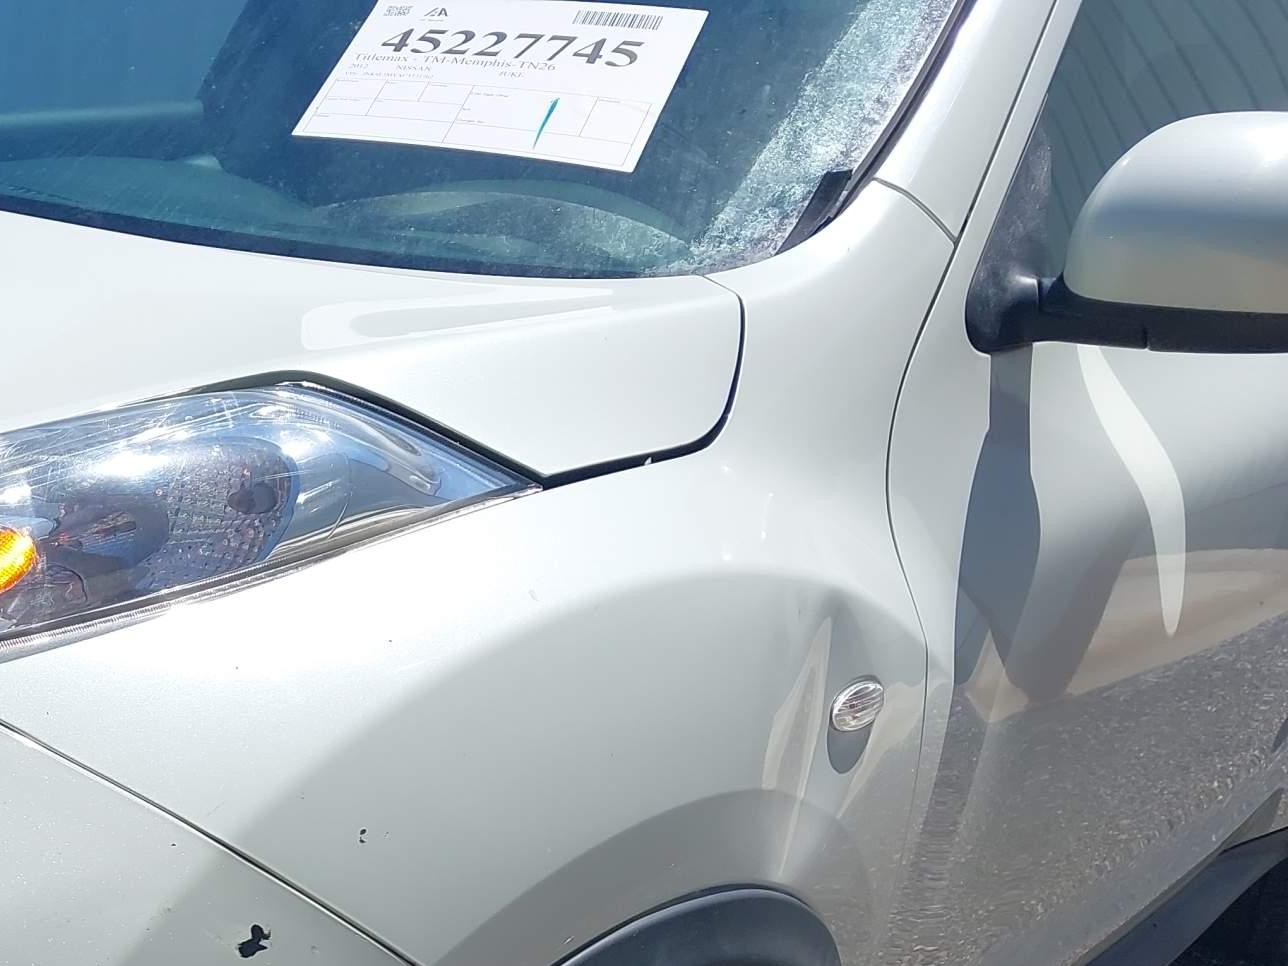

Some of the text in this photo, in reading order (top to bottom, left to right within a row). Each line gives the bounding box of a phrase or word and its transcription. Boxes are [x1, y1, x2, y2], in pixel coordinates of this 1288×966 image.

[355, 53, 409, 63] Titlemax
[423, 55, 557, 71] TM-Memphis-TN26
[380, 27, 645, 69] 45227745
